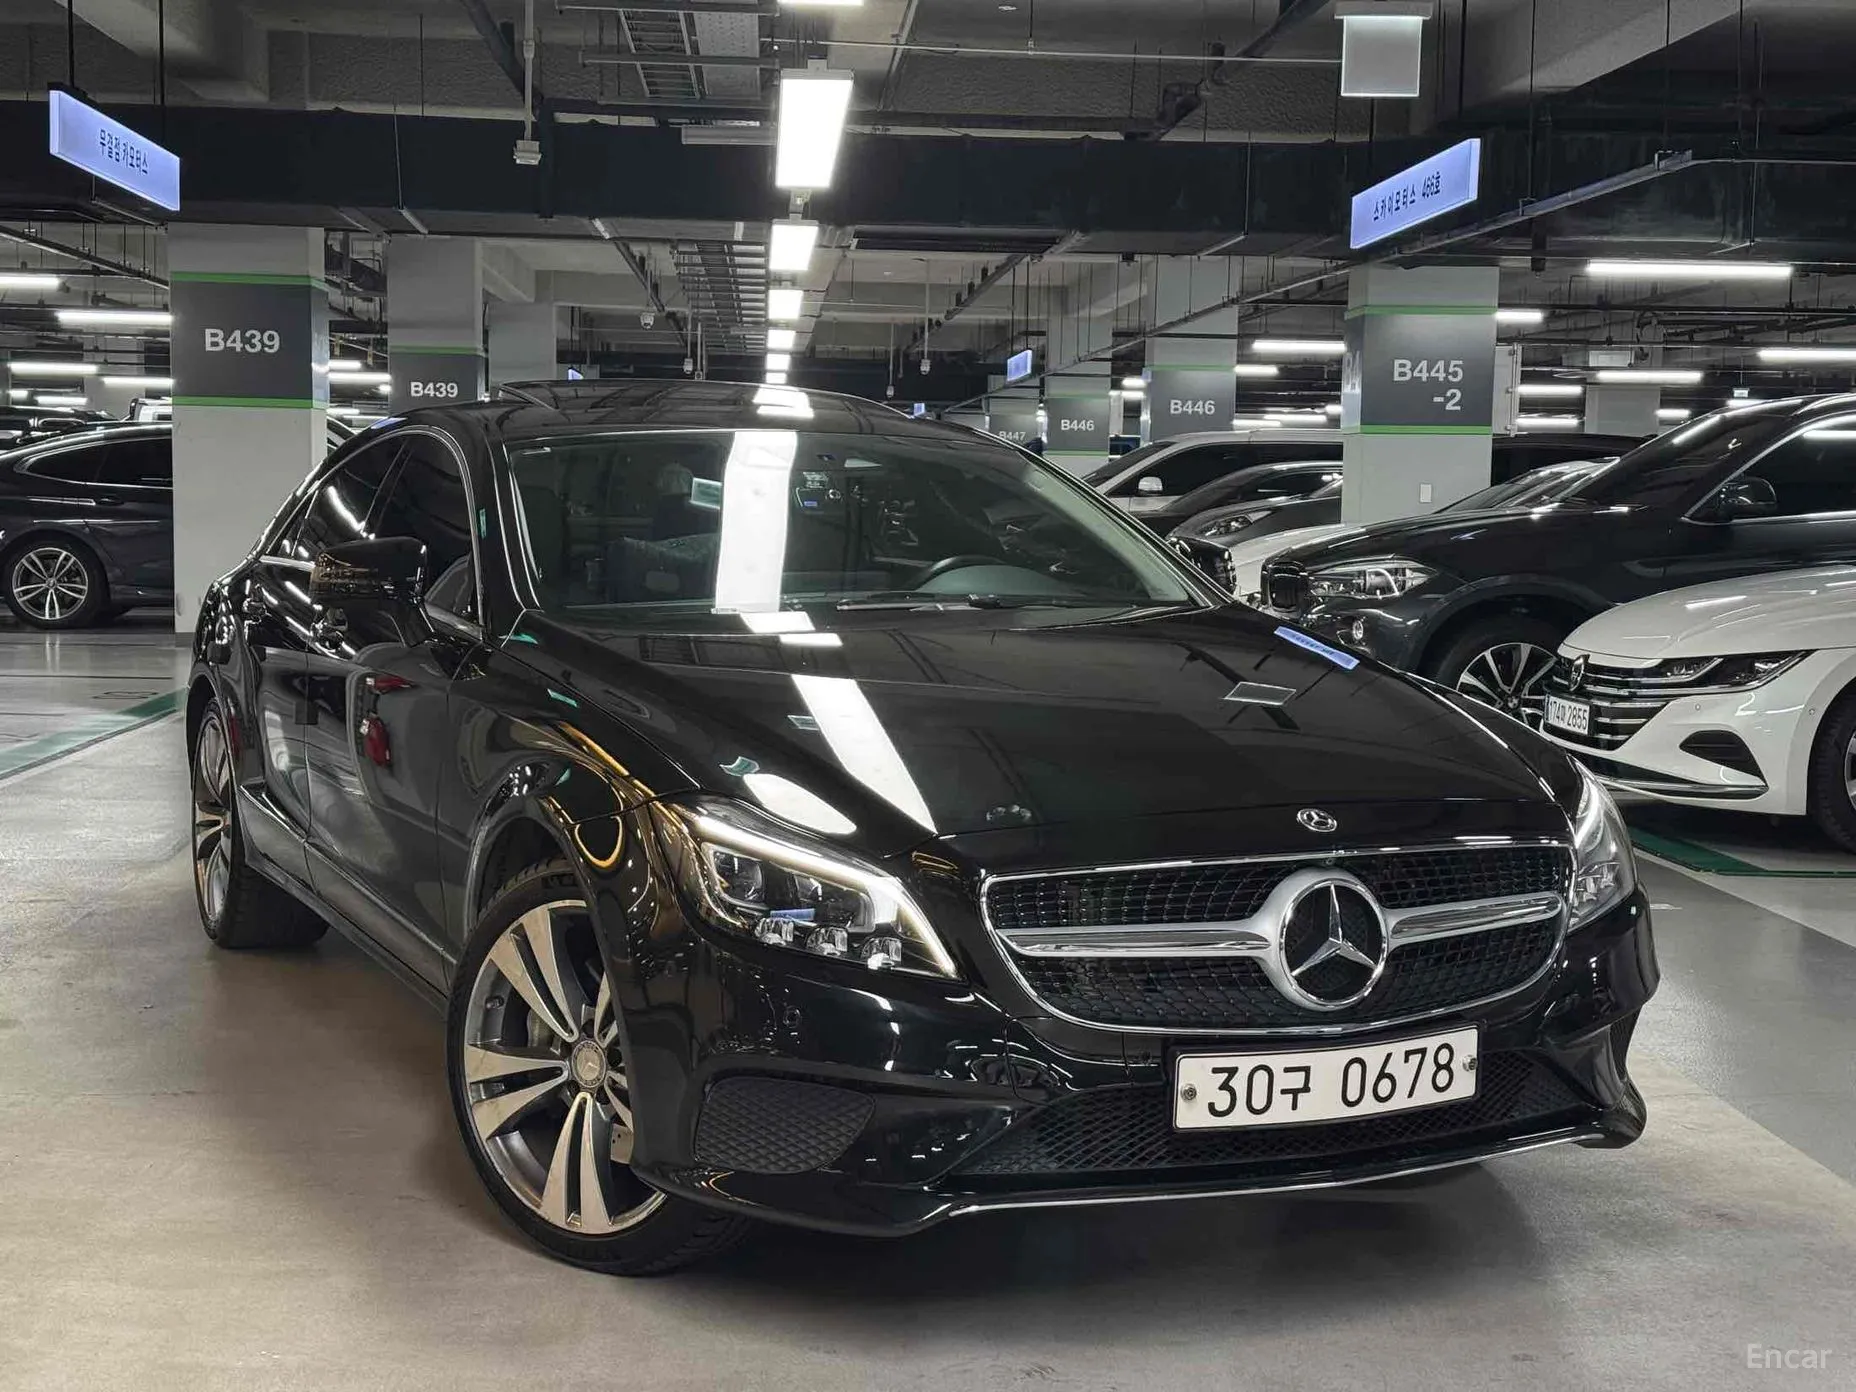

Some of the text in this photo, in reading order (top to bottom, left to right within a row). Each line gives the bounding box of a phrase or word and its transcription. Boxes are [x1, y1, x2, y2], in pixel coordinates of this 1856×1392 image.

[1373, 171, 1441, 221] 스카이모터스 466호
[205, 328, 280, 353] B439
[1393, 359, 1463, 382] B445
[410, 381, 458, 398] B439
[1433, 388, 1461, 411] -2
[1170, 399, 1216, 415] B446
[1060, 419, 1095, 431] B446
[1567, 704, 1588, 730] 2855
[1207, 1042, 1455, 1118] 30구 0678
